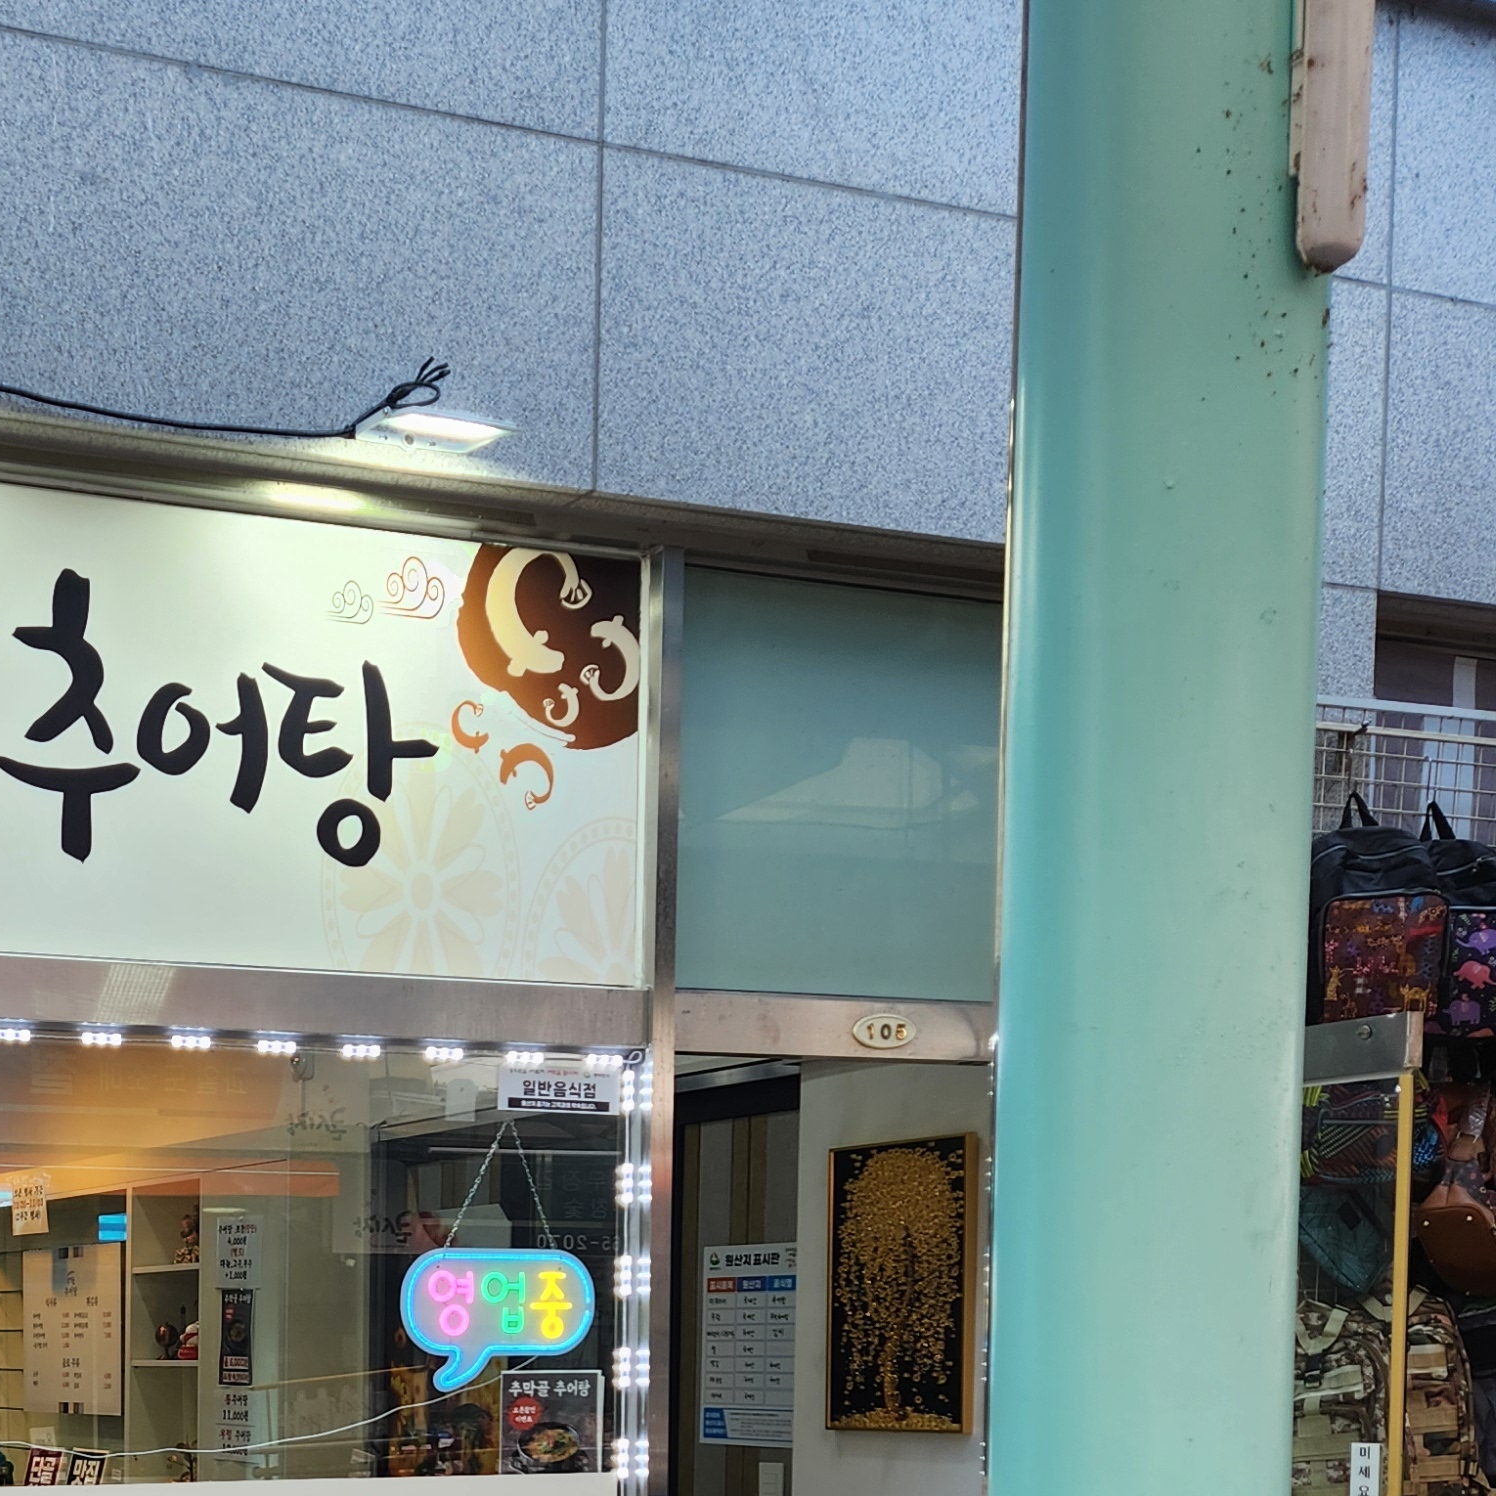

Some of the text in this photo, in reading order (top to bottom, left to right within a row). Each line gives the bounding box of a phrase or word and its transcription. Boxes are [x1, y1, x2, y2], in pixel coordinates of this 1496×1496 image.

[867, 1023, 907, 1040] 105
[523, 1080, 596, 1099] 일반음식점
[725, 1254, 752, 1267] 원산지
[753, 1252, 780, 1267] 표시판
[428, 1269, 573, 1340] 영업중
[508, 1379, 591, 1397] 추막골 추어탕
